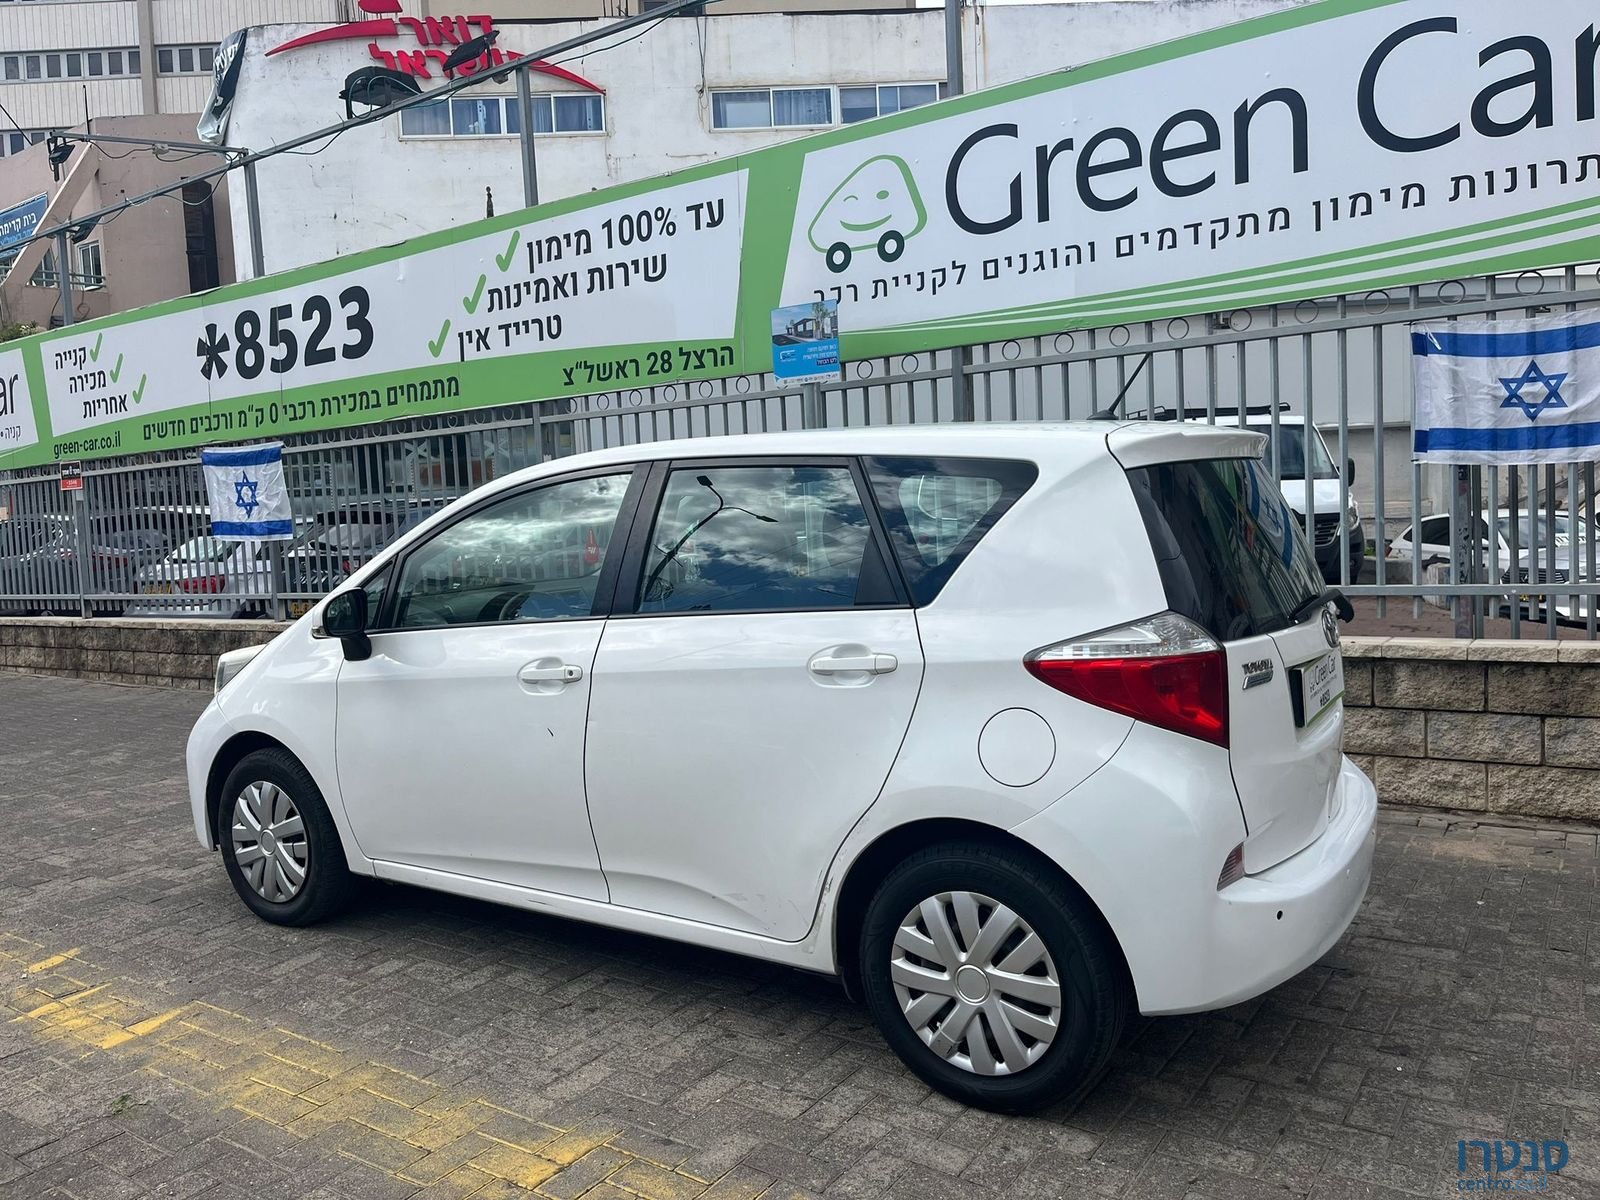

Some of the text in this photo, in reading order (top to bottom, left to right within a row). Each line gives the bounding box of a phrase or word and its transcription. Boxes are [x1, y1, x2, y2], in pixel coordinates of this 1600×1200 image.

[399, 15, 496, 46] דואר
[945, 16, 1600, 235] Green Car
[23, 213, 37, 227] בית
[1312, 182, 1426, 232] מימון
[526, 198, 725, 274] עד 100% מימון
[1115, 206, 1290, 259] מתקדמים
[982, 241, 1096, 281] והוגנים
[486, 253, 668, 313] שירות ואמינות
[871, 260, 967, 300] לקניית
[457, 314, 562, 362] טרייד אין
[54, 346, 87, 370] קנייה
[645, 349, 674, 377] 28
[678, 344, 735, 374] הרצל
[69, 370, 107, 394] מכירה
[386, 375, 460, 407] מתמחים
[82, 393, 128, 419] אחריות
[269, 402, 279, 425] 0
[282, 400, 316, 422] רכבי
[320, 389, 382, 417] במכירת
[142, 419, 186, 441] חדשים
[189, 412, 233, 435] ורכבים
[53, 430, 121, 460] green-car.co.il
